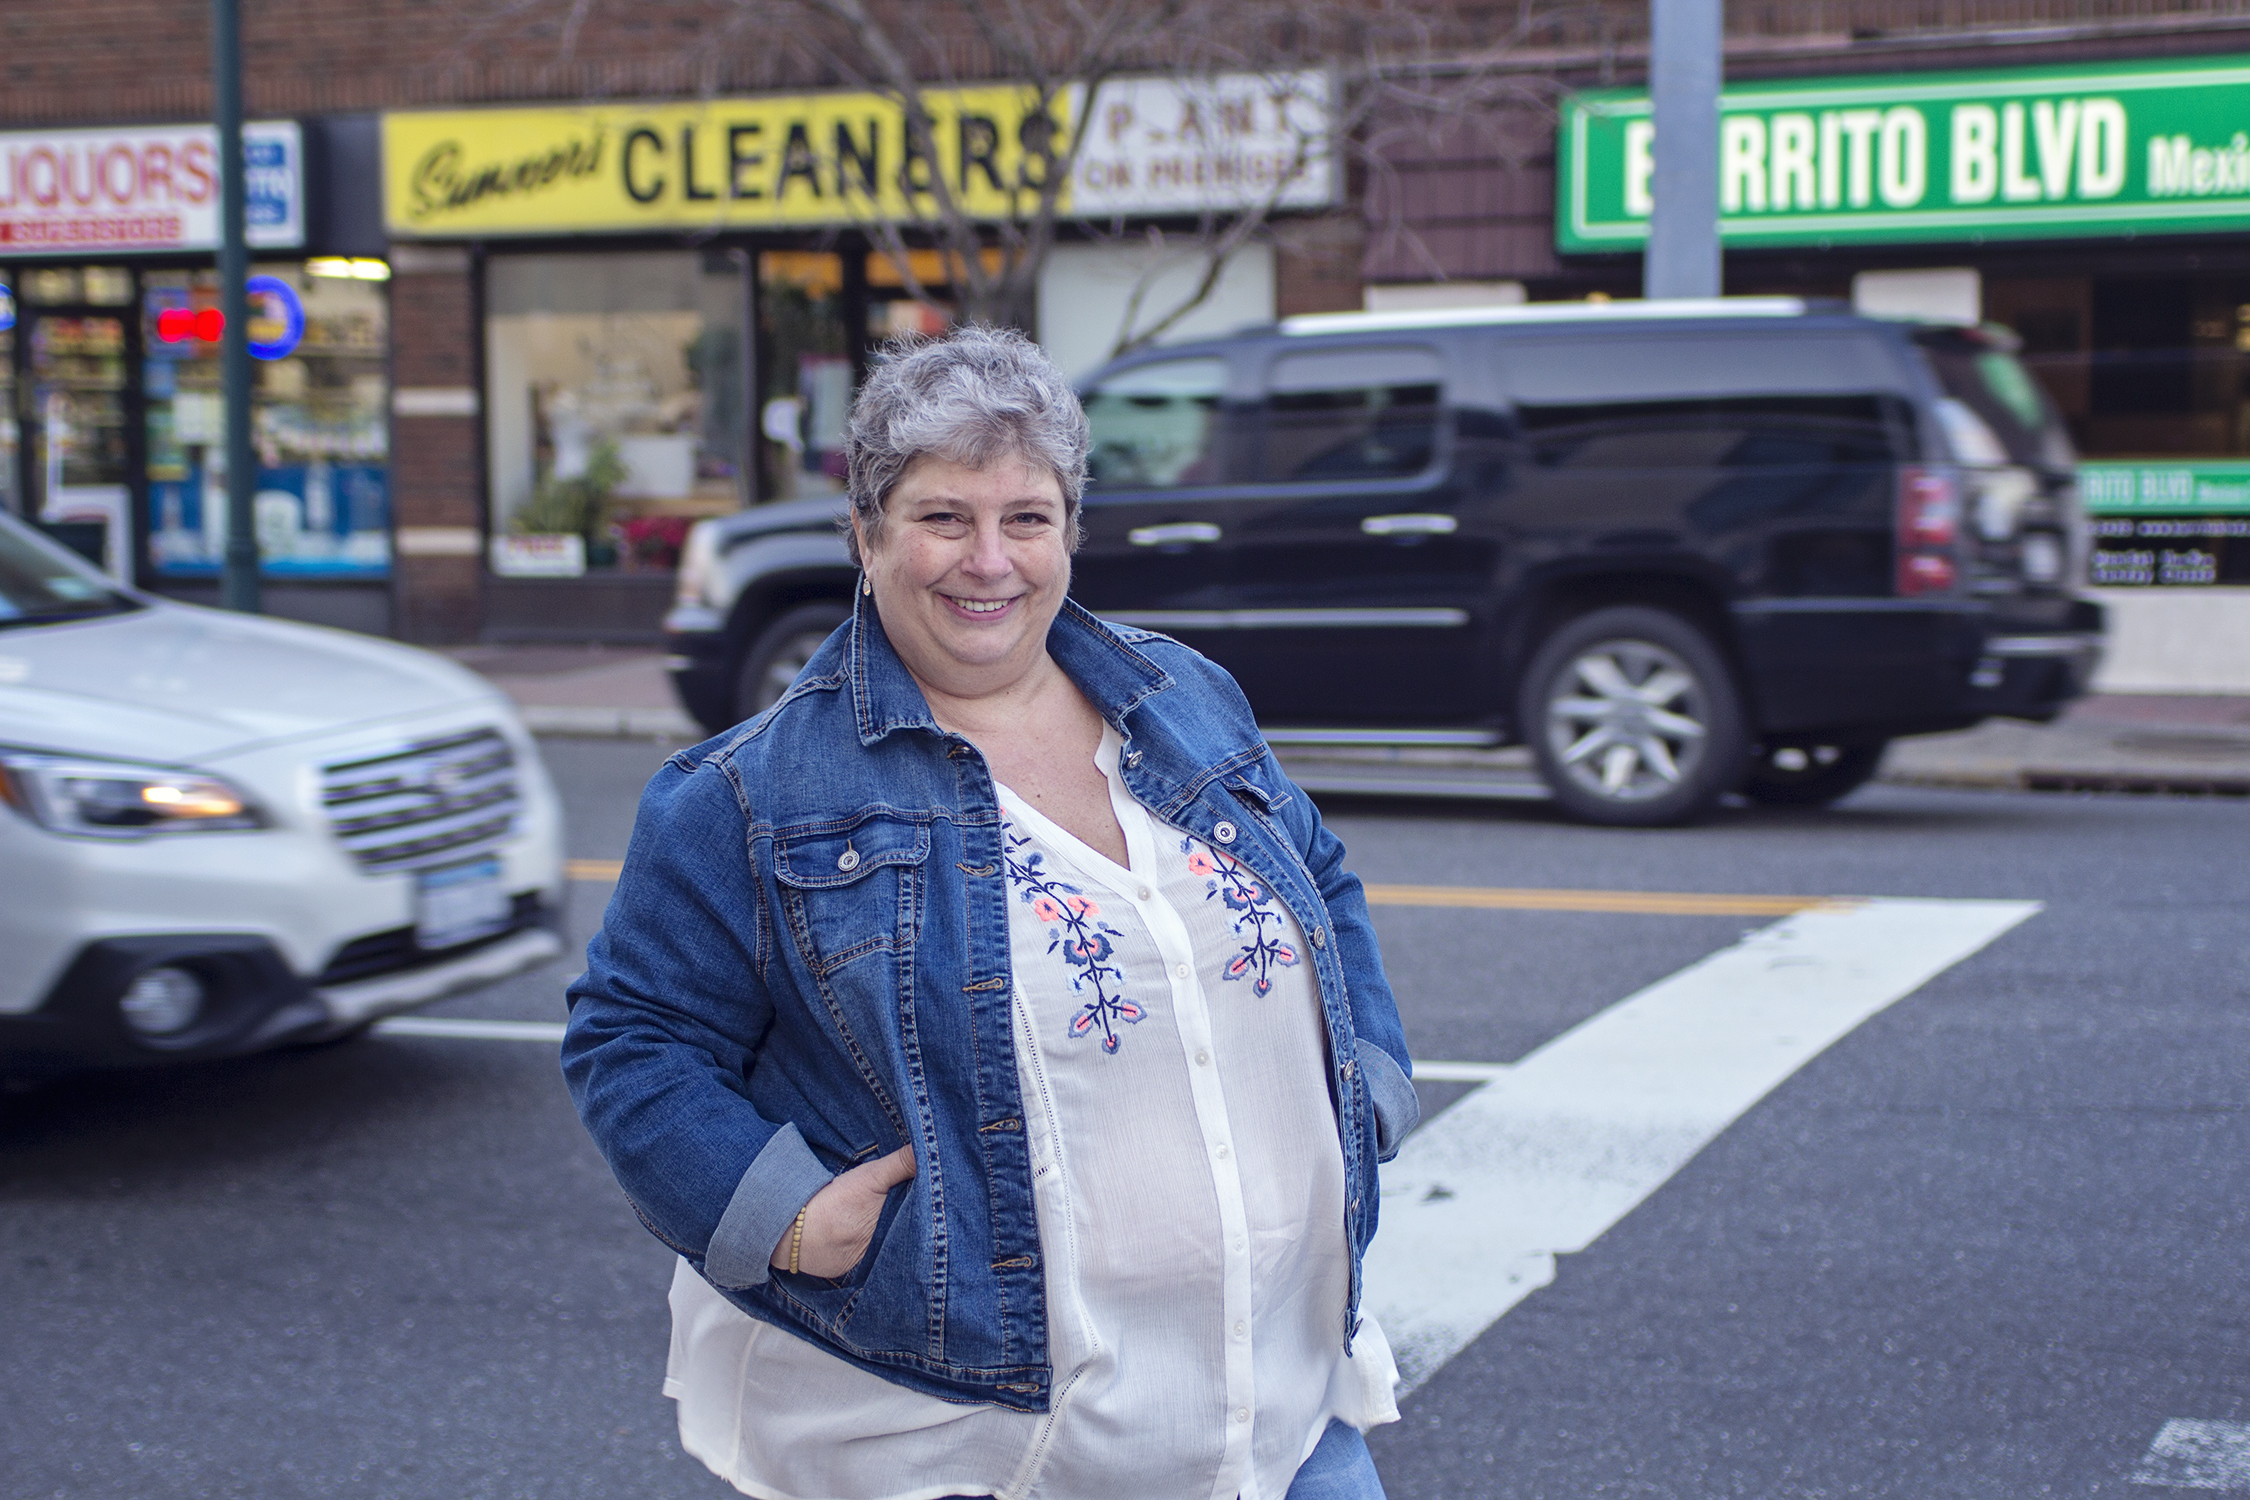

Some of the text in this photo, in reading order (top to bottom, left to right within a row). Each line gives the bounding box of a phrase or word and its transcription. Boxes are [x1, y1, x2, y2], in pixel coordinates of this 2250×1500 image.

[1107, 93, 1292, 142] PANT
[1084, 159, 1131, 190] ON
[1625, 97, 2250, 216] BRRITO BLVD Mexi
